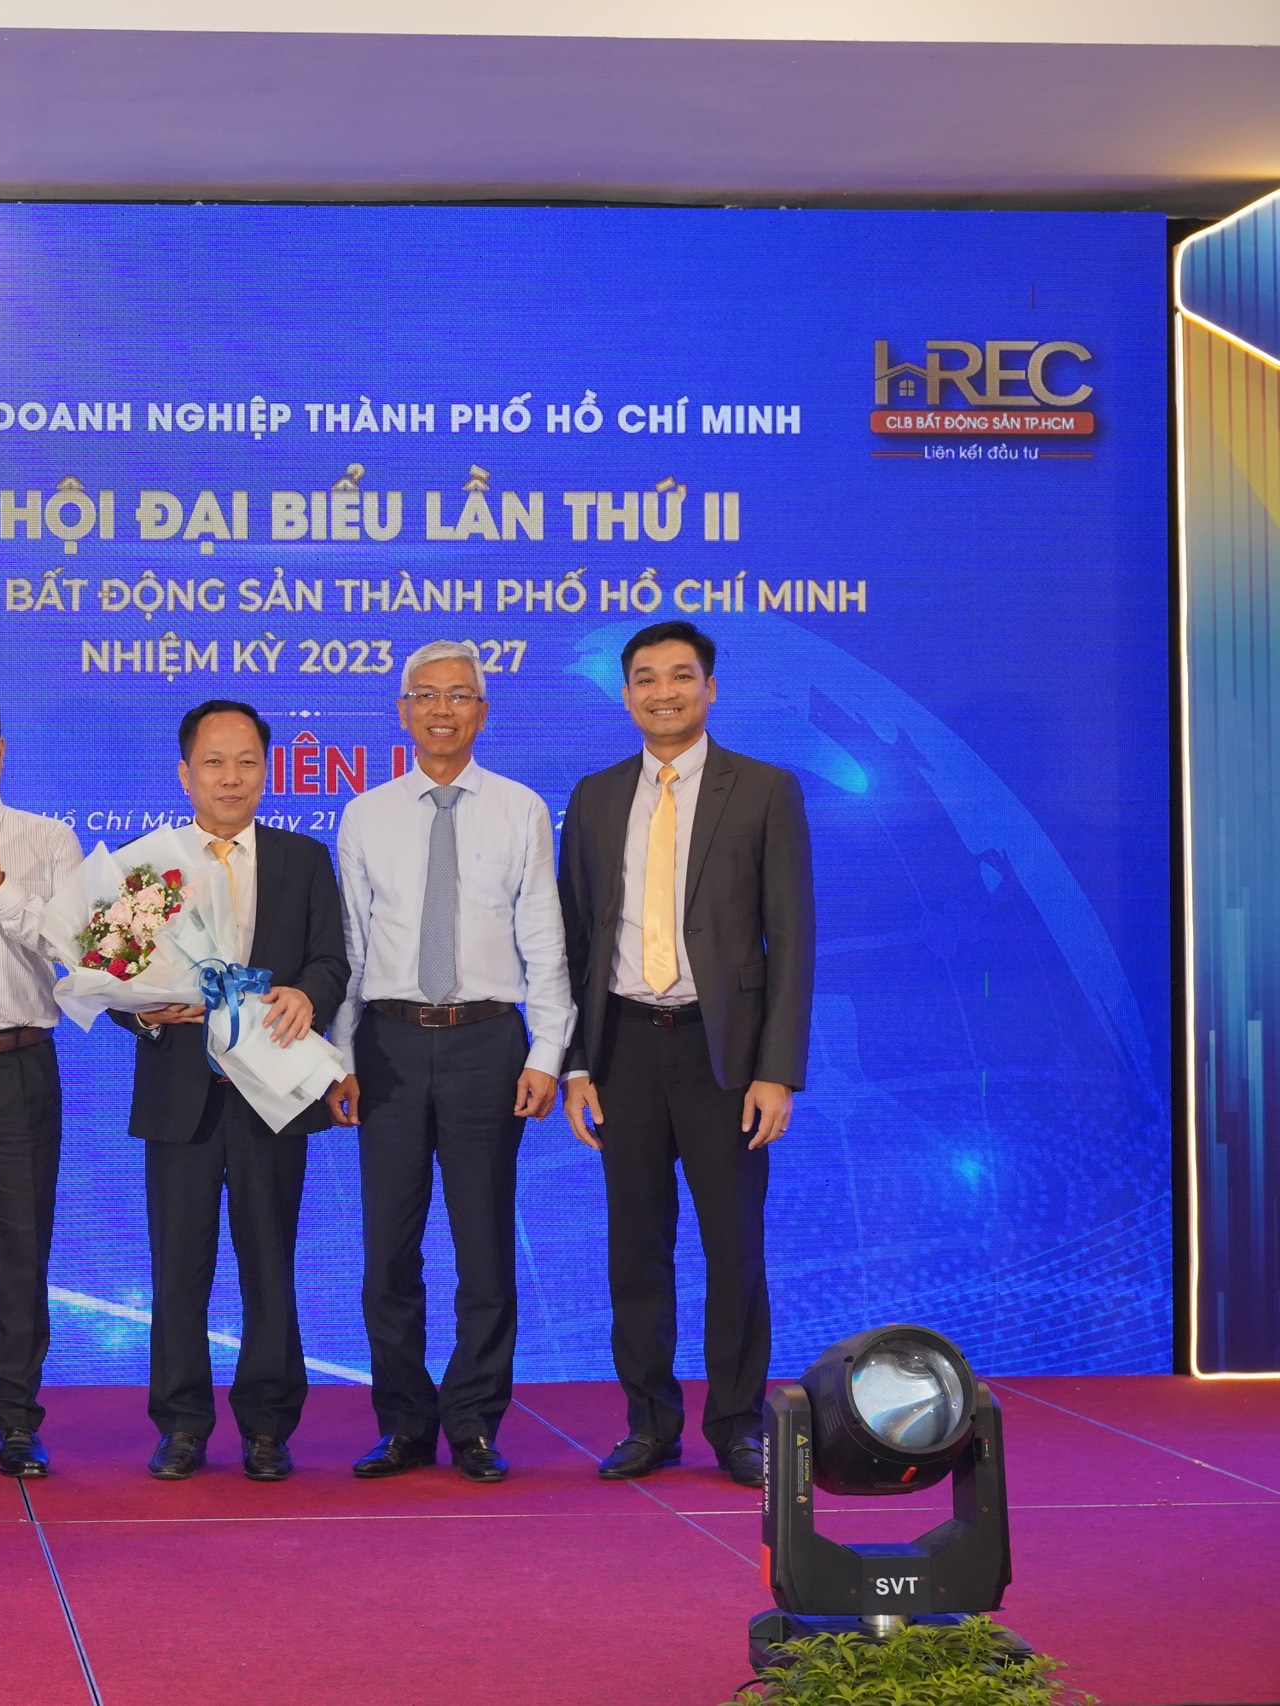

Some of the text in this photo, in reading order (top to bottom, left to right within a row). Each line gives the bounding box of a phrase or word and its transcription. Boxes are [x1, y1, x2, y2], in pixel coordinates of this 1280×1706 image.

[874, 340, 1094, 406] HREC
[148, 396, 292, 440] NGHIỆP
[305, 395, 435, 433] THÀNH
[451, 391, 532, 433] PHỐ
[547, 389, 604, 434] HỒ
[618, 396, 689, 434] CHÍ
[701, 404, 802, 434] MINH
[885, 412, 1075, 431] CLB BẤT ĐỘNG SẢN TP.HCM
[924, 443, 1039, 460] Liên kết đầu tư
[0, 475, 116, 554] HỘI
[135, 489, 249, 554] ĐẠI
[271, 463, 403, 541] BIỂU
[424, 464, 545, 541] LẦN
[563, 475, 688, 542] THỨ
[704, 491, 740, 541] II
[6, 566, 88, 612] BẤT
[97, 568, 226, 621] ĐỘNG
[238, 566, 323, 613] SẢN
[334, 569, 484, 613] THÀNH
[496, 566, 588, 613] PHỐ
[599, 566, 663, 613] HỒ
[673, 569, 749, 613] CHÍ
[757, 578, 867, 613] MINH
[81, 631, 219, 682] NHIỆM
[232, 631, 286, 673] KỲ
[297, 638, 395, 674] 2023
[87, 809, 135, 831] Chí
[309, 810, 337, 831] 21
[875, 1576, 919, 1596] SVT
